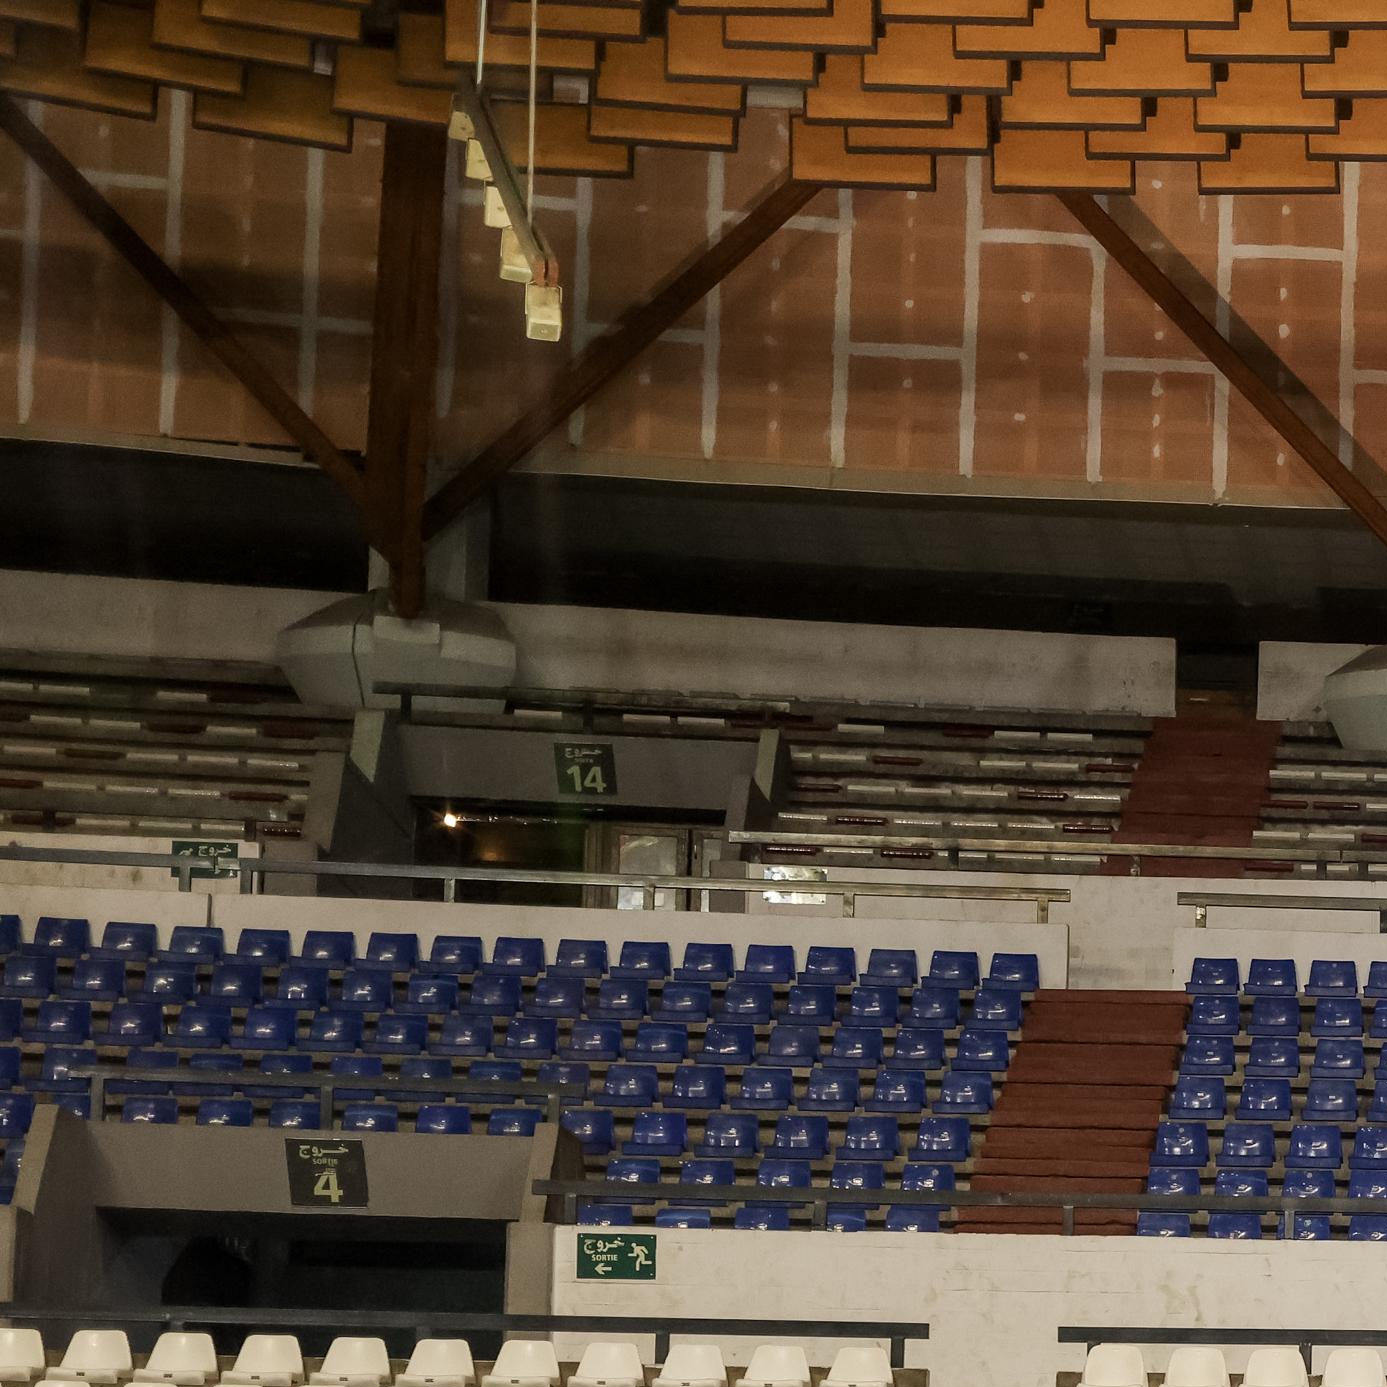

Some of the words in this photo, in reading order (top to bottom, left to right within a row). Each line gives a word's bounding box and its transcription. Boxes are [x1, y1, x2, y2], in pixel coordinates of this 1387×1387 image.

[566, 765, 607, 793] 14
[299, 1143, 349, 1158] خروج
[314, 1168, 343, 1202] 4
[584, 1236, 625, 1254] خروج
